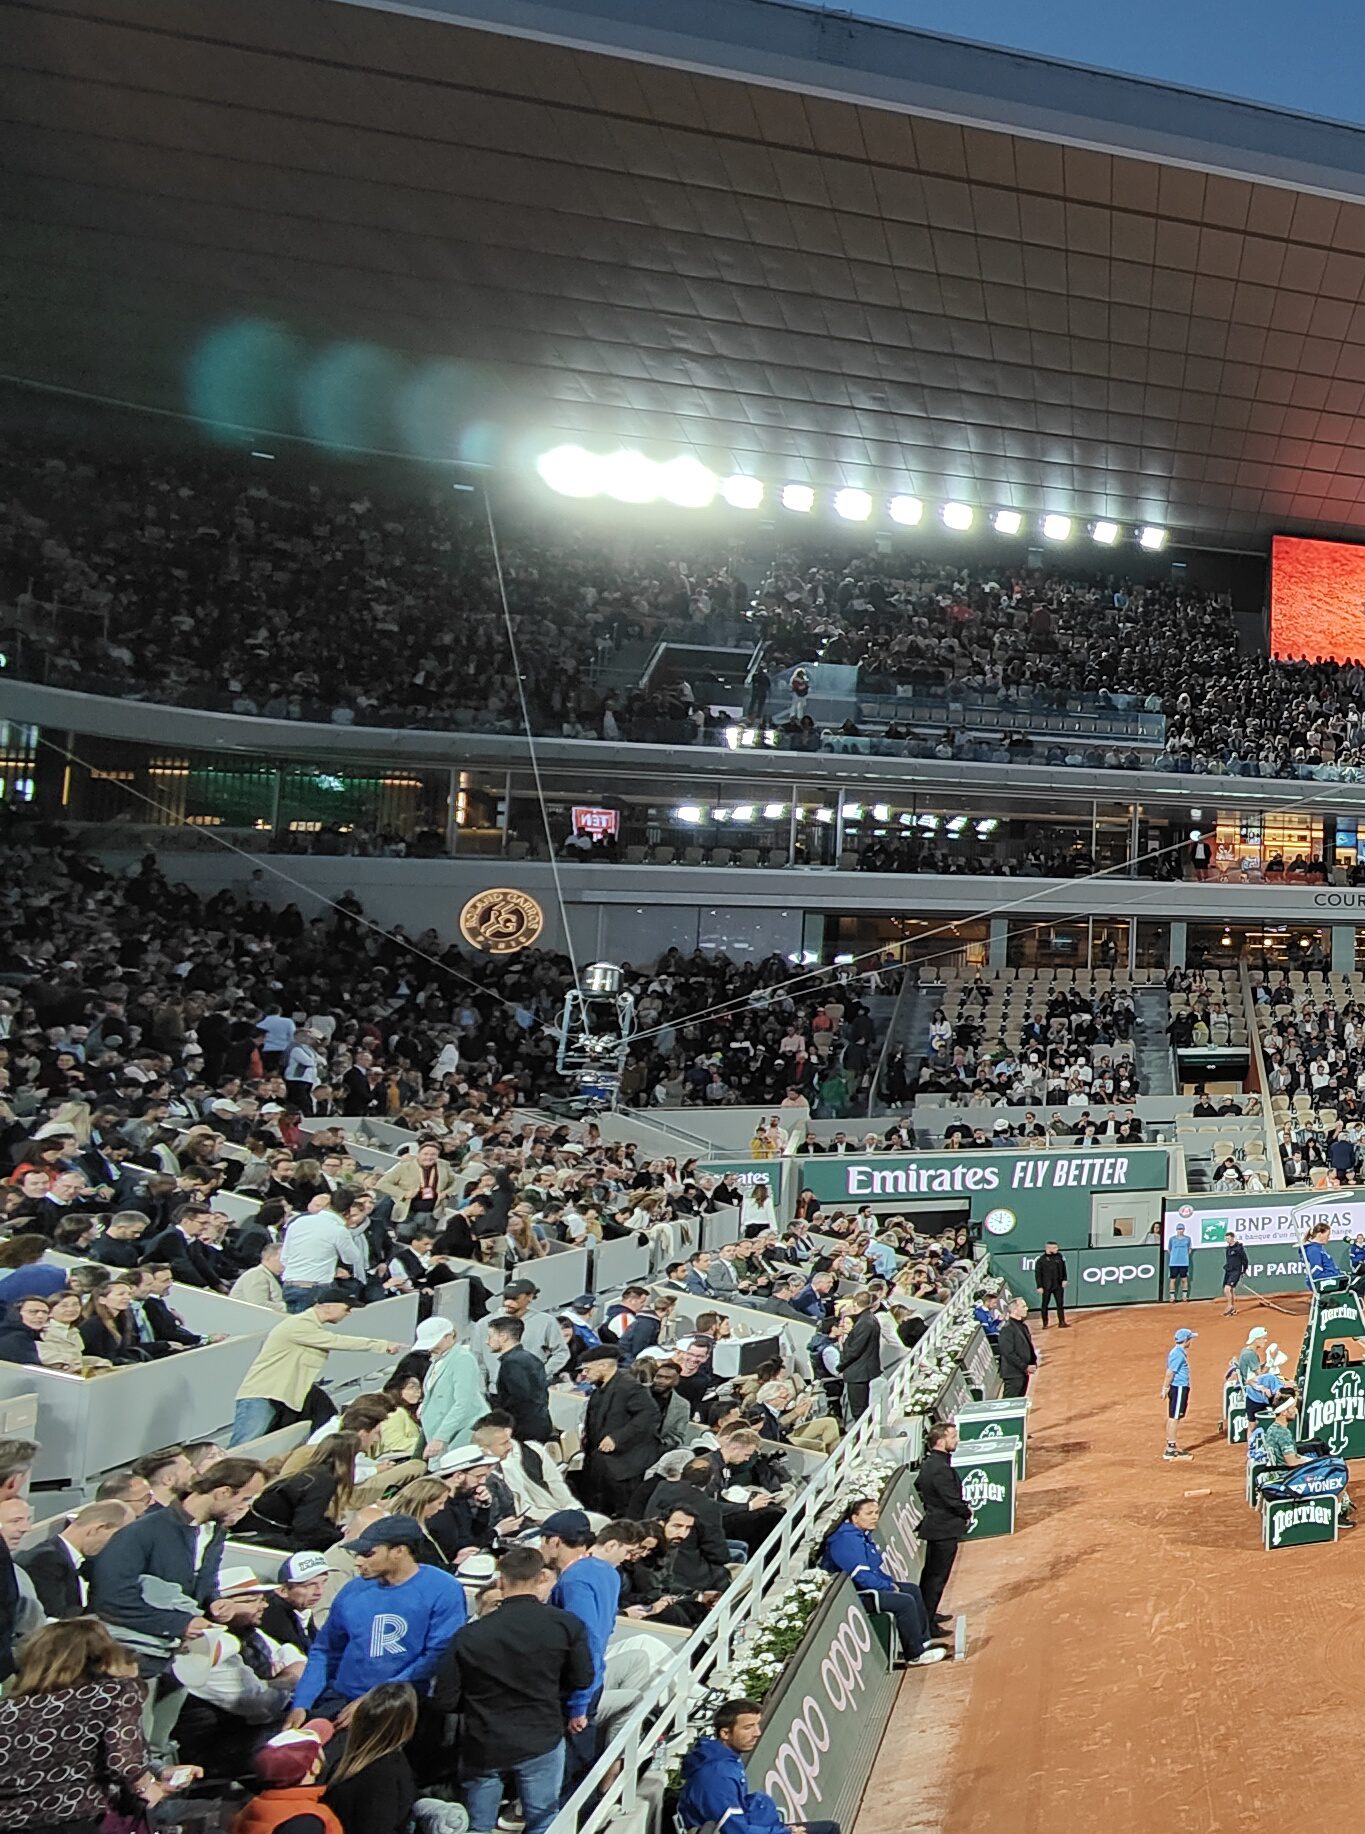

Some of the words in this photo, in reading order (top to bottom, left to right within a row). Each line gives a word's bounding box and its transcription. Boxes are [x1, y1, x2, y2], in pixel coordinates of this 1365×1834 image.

[465, 893, 503, 929] ROLAND
[506, 893, 539, 930] GARROS
[847, 1163, 999, 1195] Emirates
[1012, 1160, 1052, 1189] FLY
[1053, 1157, 1129, 1187] BETTER
[1235, 1216, 1273, 1232] BNP
[1278, 1212, 1352, 1230] PARIBAS
[1083, 1264, 1155, 1286] oppo
[1241, 1264, 1264, 1278] NP
[1320, 1303, 1358, 1331] perrier
[961, 1482, 1006, 1502] rrier
[1308, 1477, 1344, 1493] YONEX
[1272, 1501, 1332, 1546] perrier
[369, 1613, 409, 1658] R
[821, 1604, 871, 1712] oppo
